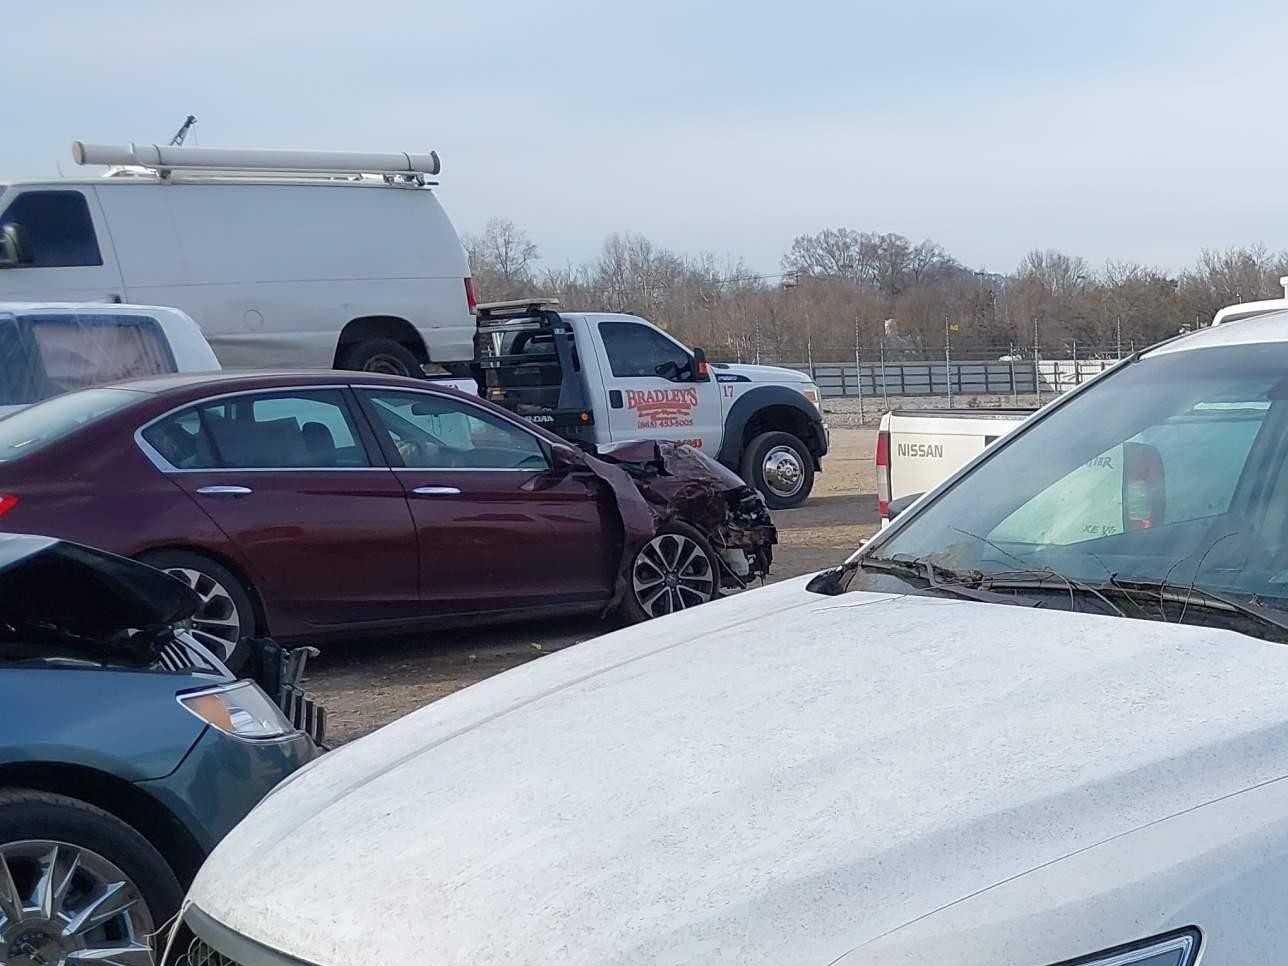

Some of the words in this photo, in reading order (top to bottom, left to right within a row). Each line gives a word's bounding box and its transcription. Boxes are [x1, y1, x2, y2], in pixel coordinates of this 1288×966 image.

[625, 387, 699, 410] BRADLEY'S
[723, 385, 734, 398] 17
[897, 443, 943, 458] NISSAN
